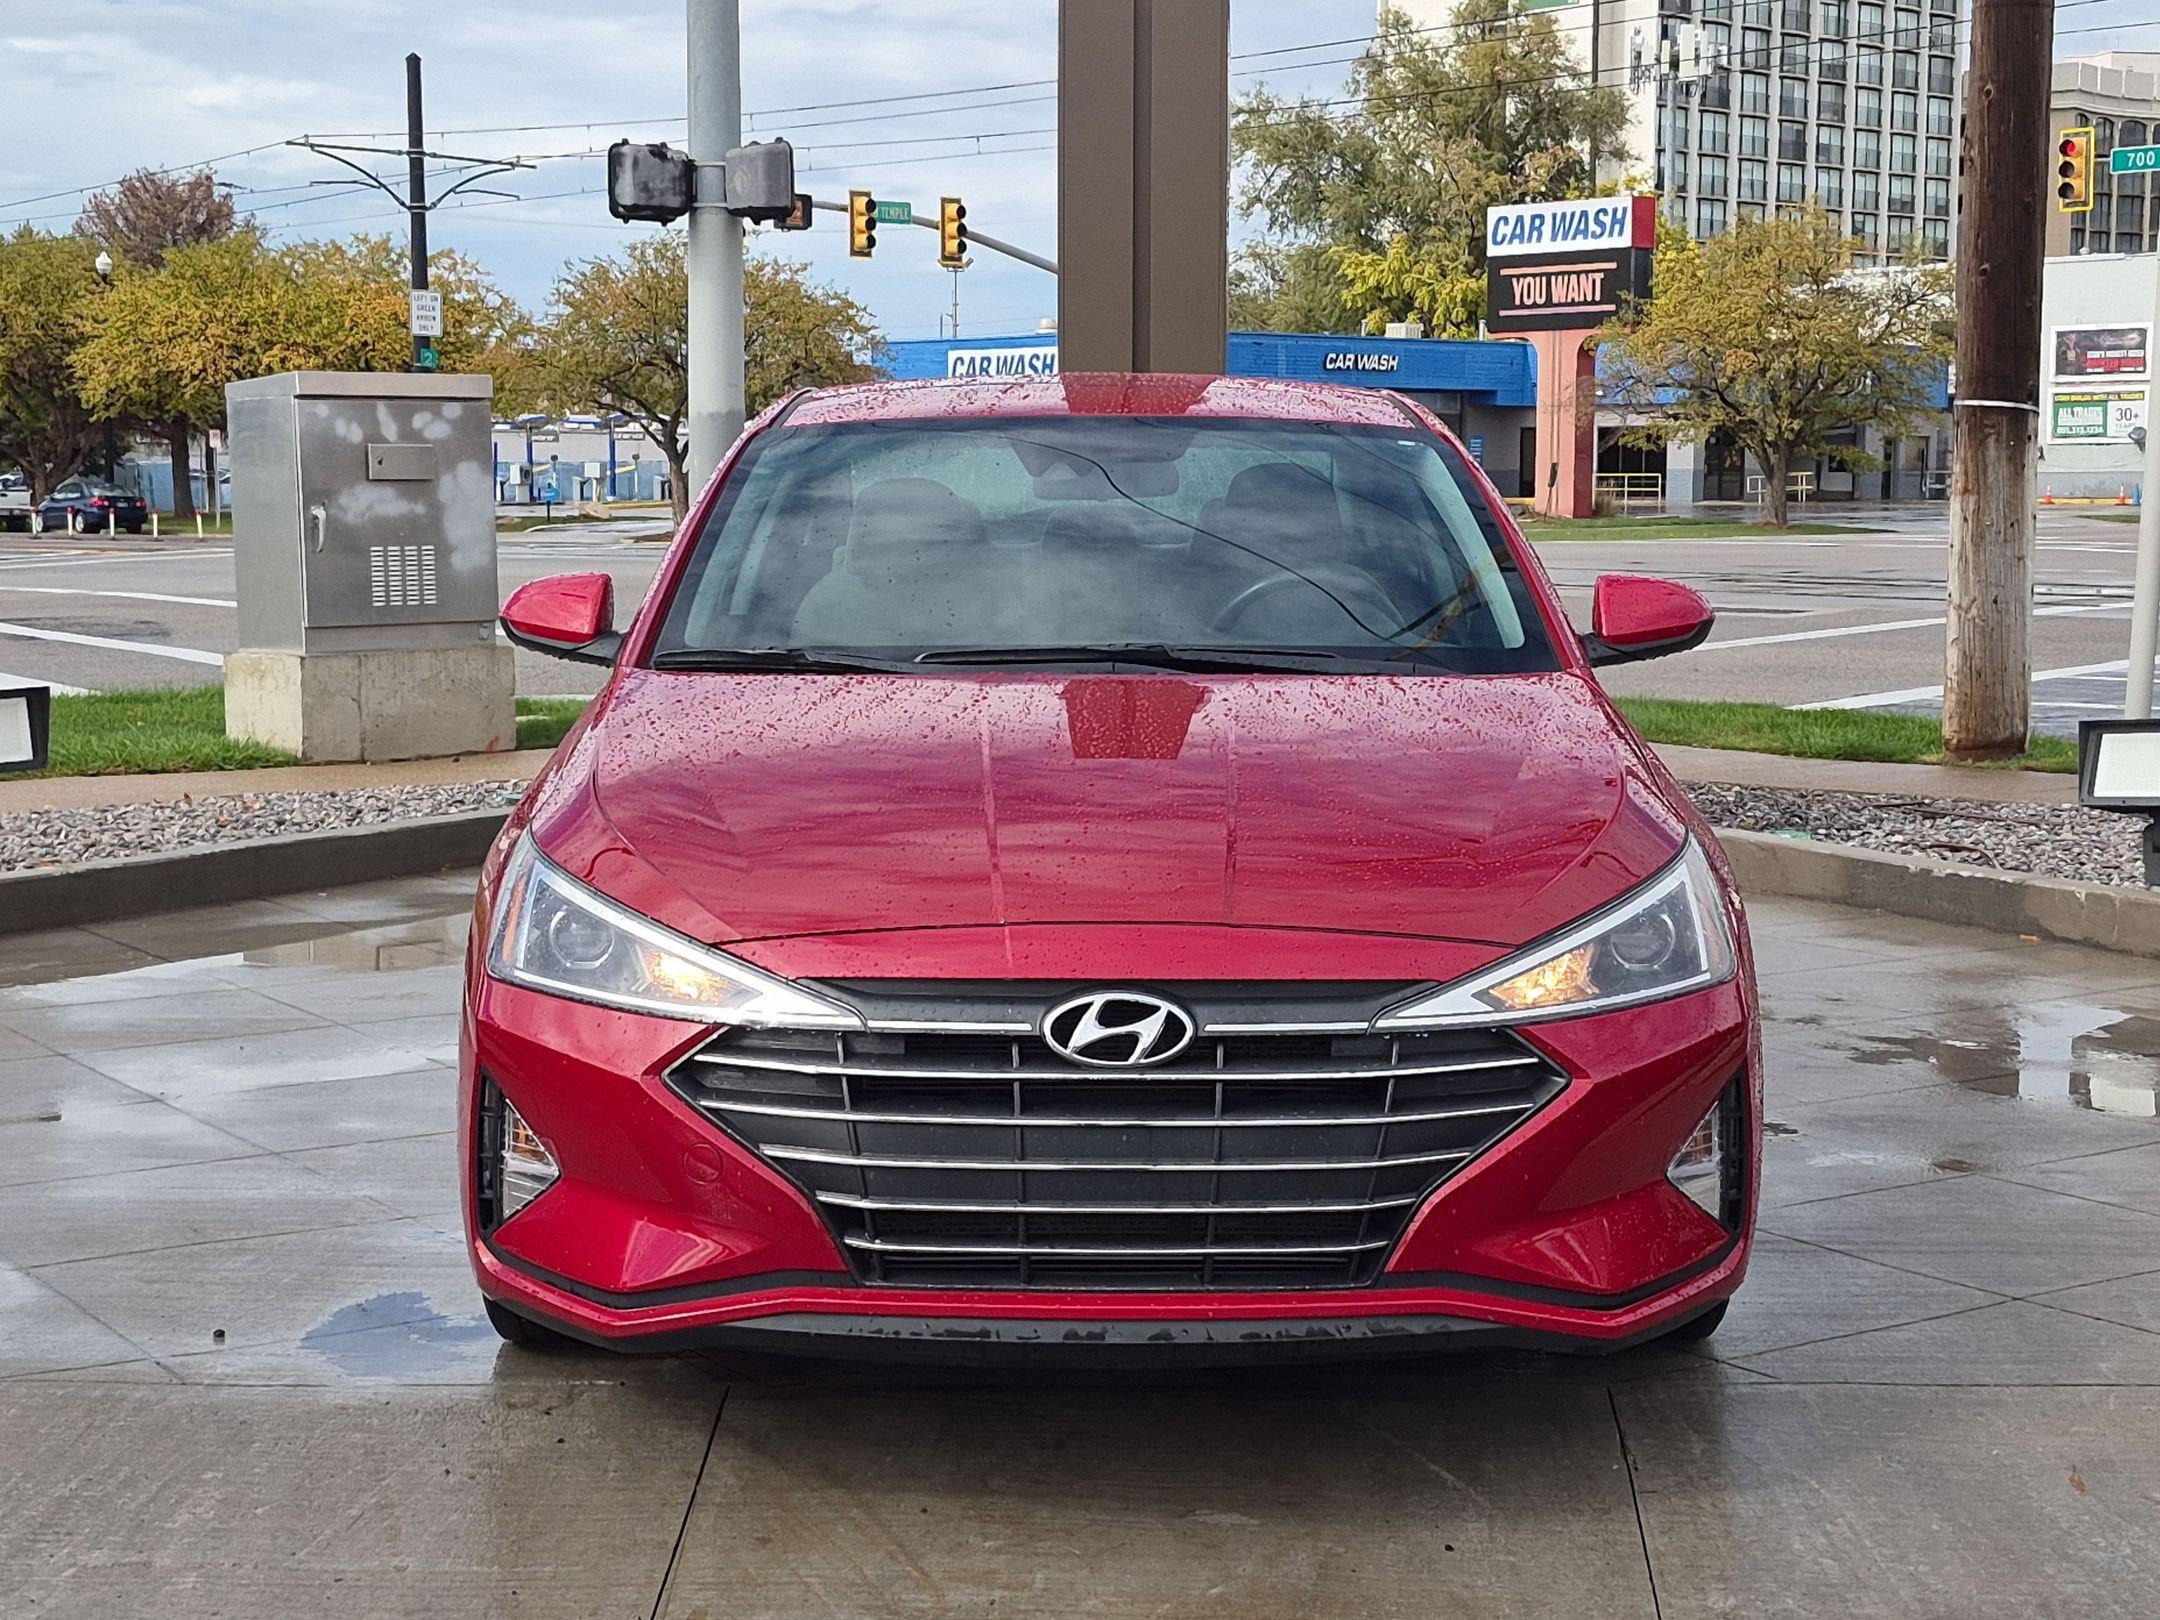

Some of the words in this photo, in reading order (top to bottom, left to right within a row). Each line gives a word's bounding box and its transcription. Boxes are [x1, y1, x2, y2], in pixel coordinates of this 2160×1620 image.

[2127, 151, 2155, 167] 700
[1492, 213, 1545, 246] CAR
[1550, 207, 1628, 242] WASH
[1512, 276, 1546, 306] YOU
[1551, 272, 1604, 304] WANT
[952, 356, 992, 377] CAR
[996, 353, 1056, 376] WASH
[1326, 353, 1355, 370] CAR
[1357, 353, 1399, 371] WASH
[2115, 407, 2139, 421] 30+
